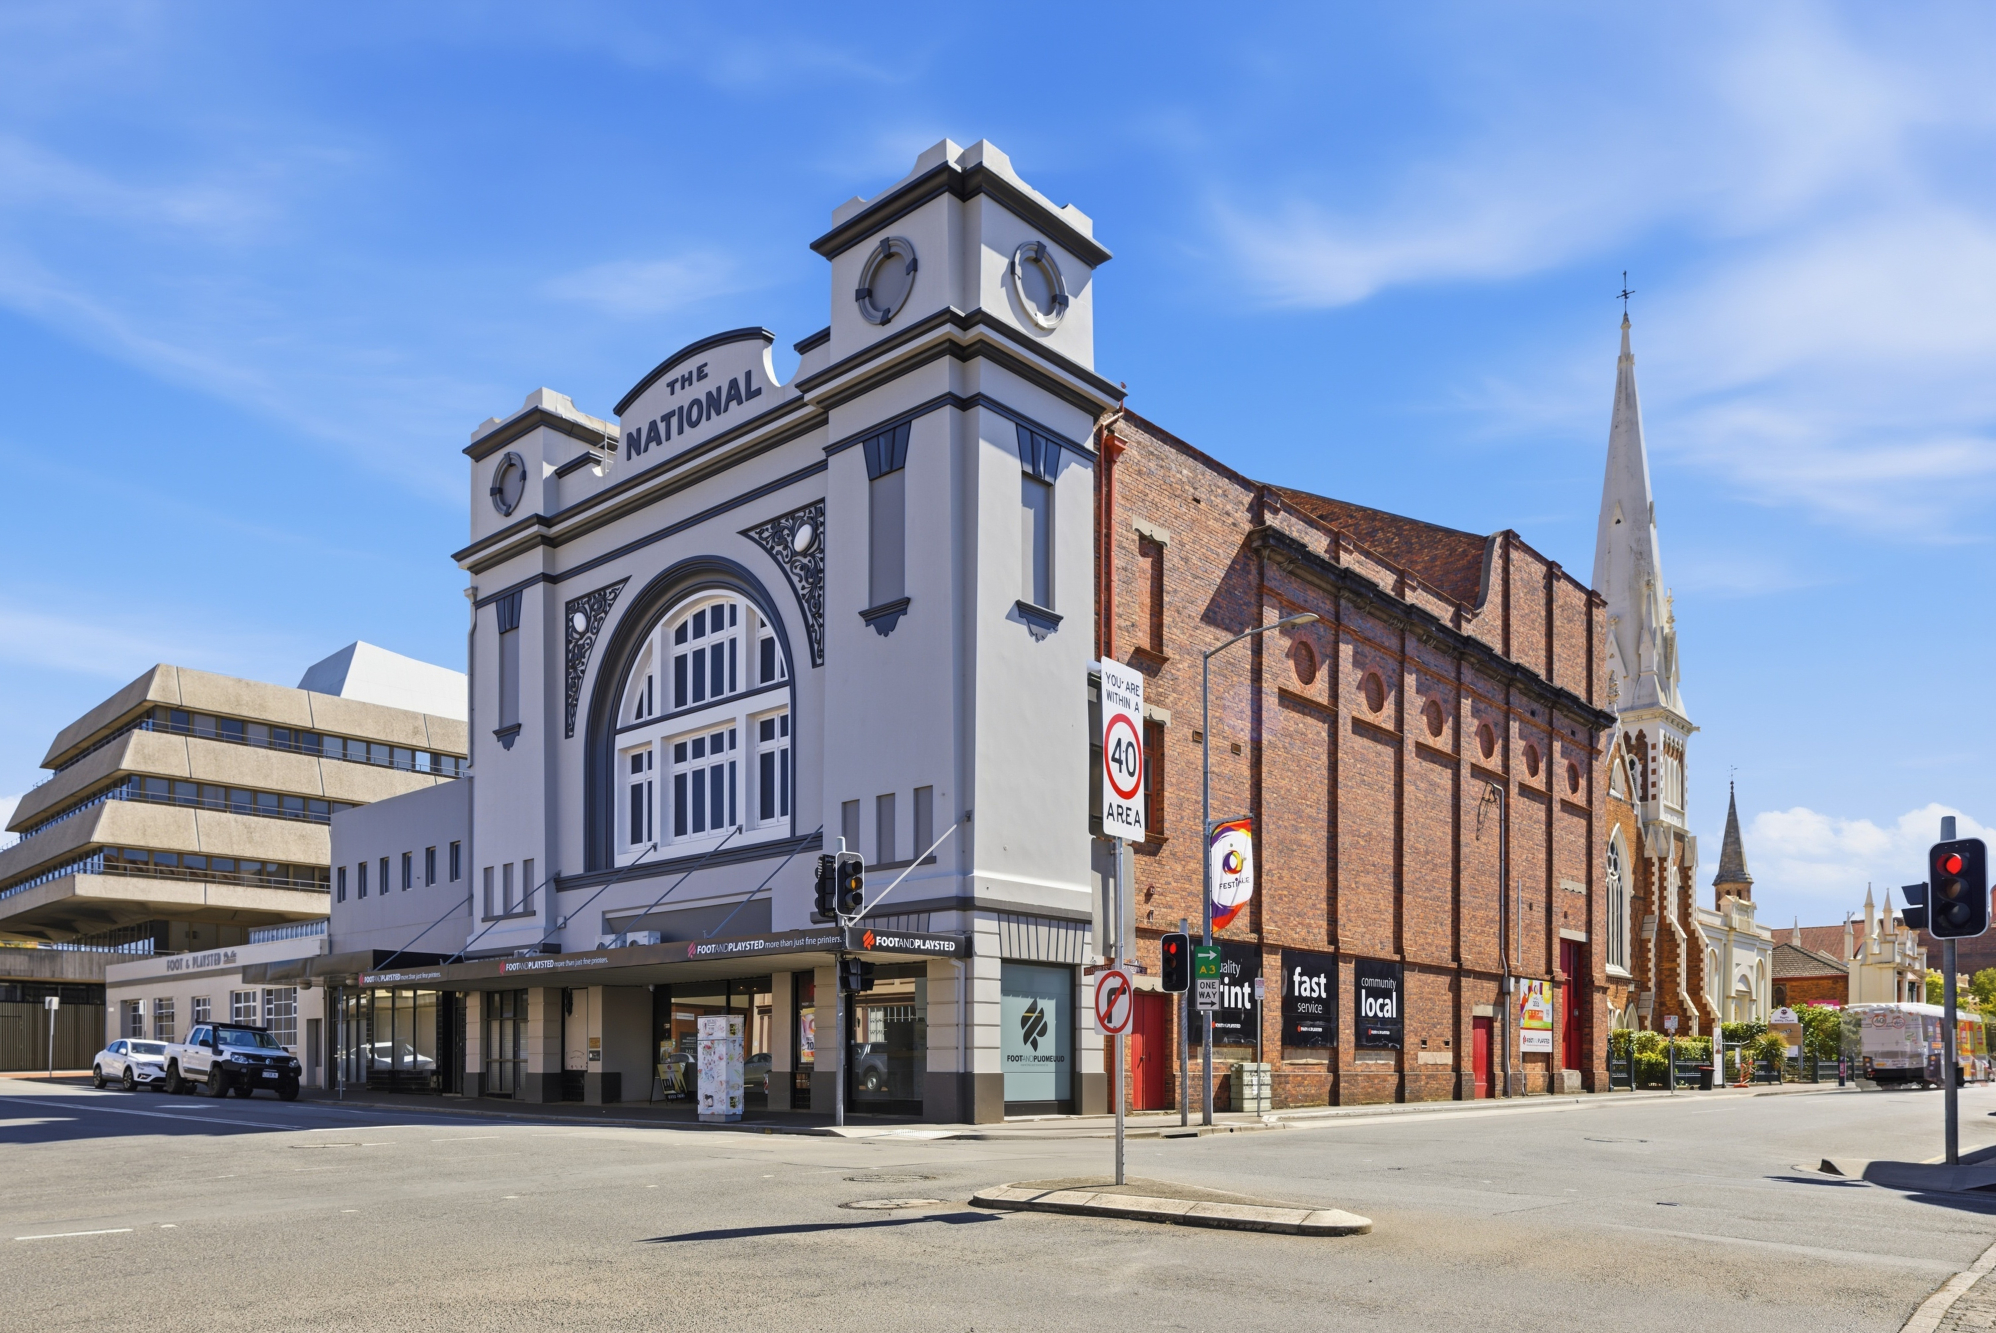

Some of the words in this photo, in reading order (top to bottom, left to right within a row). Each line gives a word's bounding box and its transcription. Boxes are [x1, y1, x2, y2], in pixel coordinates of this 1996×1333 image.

[666, 362, 709, 396] THE
[626, 369, 762, 462] NATIONAL
[1105, 672, 1122, 689] YOU
[1125, 680, 1141, 698] ARE
[1105, 688, 1131, 708] WITHIN
[1134, 701, 1140, 714] A
[1110, 737, 1137, 778] 40
[1106, 802, 1142, 829] AREA
[764, 941, 780, 949] more
[780, 938, 793, 948] than
[793, 938, 805, 948] just
[805, 936, 817, 945] fine
[875, 936, 956, 951] FOOTANDPLAYSTED
[167, 958, 183, 972] FOOT
[186, 959, 190, 970] &
[192, 952, 222, 969] PLAYSTED
[1199, 965, 1216, 974] A3
[1219, 959, 1241, 978] ality
[1199, 981, 1217, 989] ONE
[1220, 976, 1251, 1010] int
[1293, 966, 1327, 999] fast
[1361, 977, 1397, 992] community
[1198, 991, 1218, 999] WAY
[1361, 989, 1397, 1018] local
[1297, 1002, 1323, 1014] service
